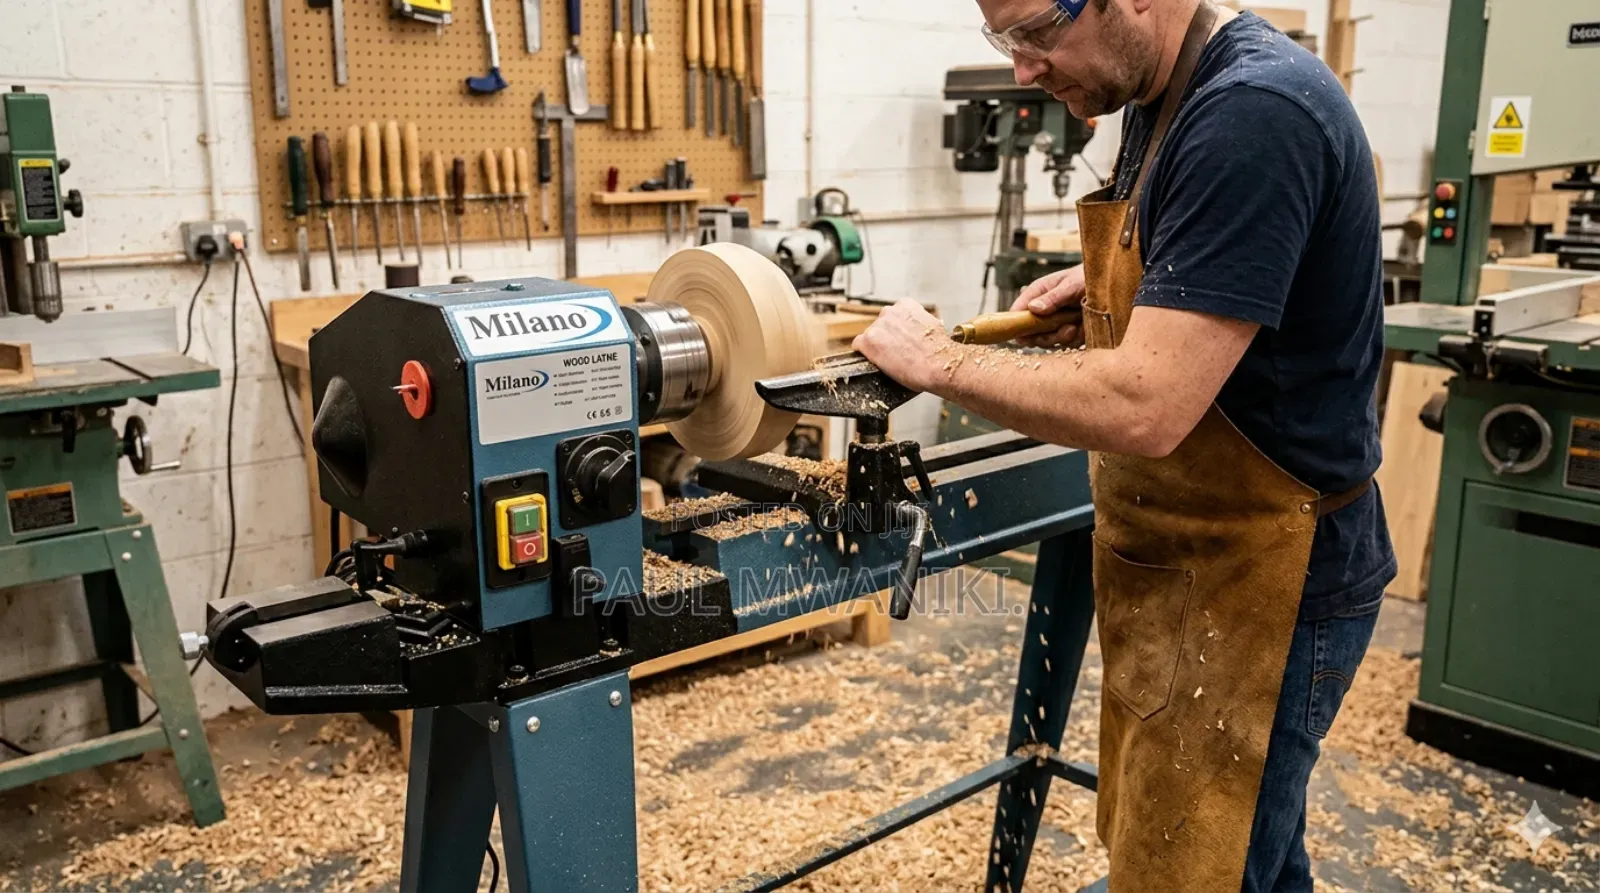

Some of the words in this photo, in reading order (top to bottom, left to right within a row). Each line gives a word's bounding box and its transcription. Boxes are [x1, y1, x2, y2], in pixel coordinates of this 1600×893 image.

[465, 311, 587, 340] Milano
[563, 356, 590, 367] WOOD
[485, 375, 540, 393] Milano
